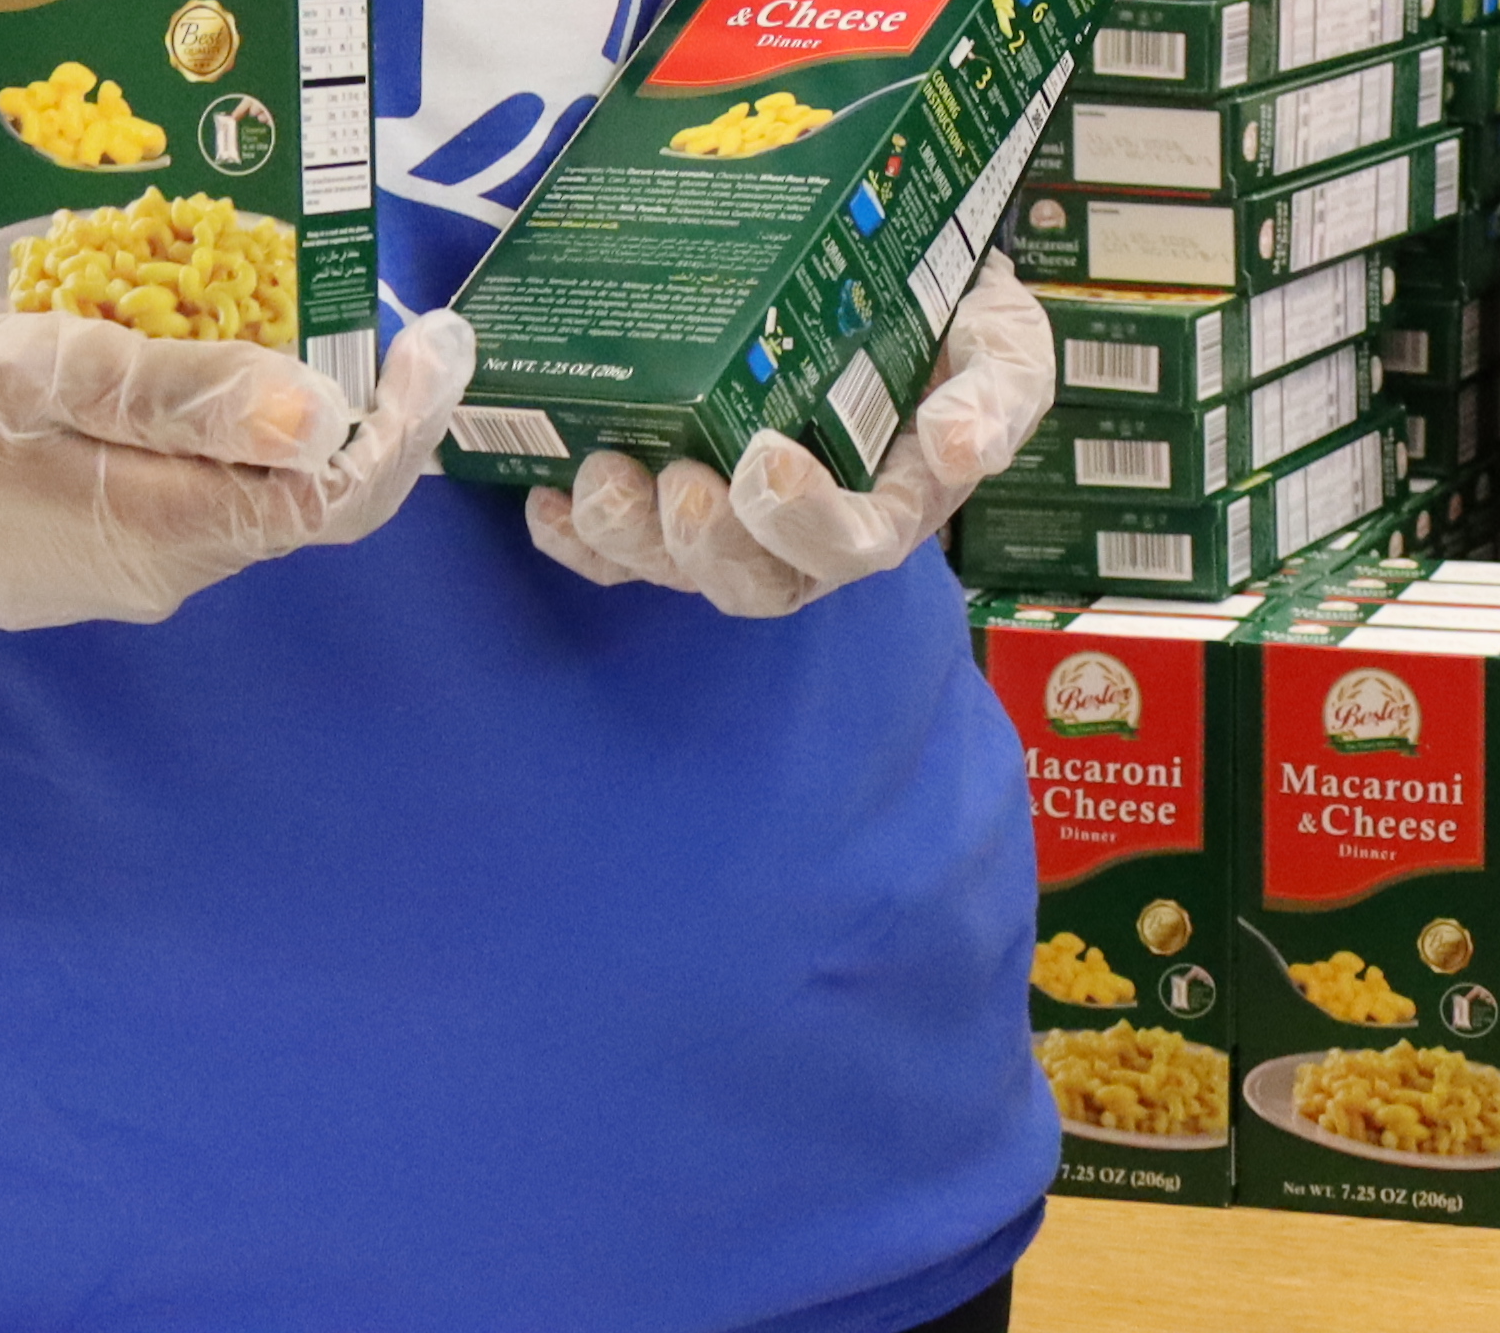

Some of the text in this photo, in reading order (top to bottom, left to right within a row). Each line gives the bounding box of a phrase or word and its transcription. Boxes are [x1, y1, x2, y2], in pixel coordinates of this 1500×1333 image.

[1032, 2, 1049, 24] 6
[180, 21, 224, 47] Best
[756, 34, 822, 50] Dinner
[1008, 29, 1026, 55] 2
[975, 65, 992, 90] 3
[932, 69, 962, 120] COOKING
[922, 82, 966, 159] INSTRUCTIONS
[932, 164, 954, 203] WATER
[1013, 234, 1080, 255] Macaroni
[483, 357, 508, 372] Net
[539, 360, 567, 375] 7.25
[568, 361, 591, 376] OZ
[1280, 761, 1464, 806] Macaroni
[1059, 826, 1117, 843] Dinner
[1338, 842, 1398, 861] Dinner
[1060, 1163, 1181, 1192] 7.25 OZ (206g)
[1283, 1180, 1306, 1195] Net
[1341, 1183, 1376, 1202] 7.25
[1379, 1188, 1407, 1205] OZ
[1411, 1190, 1464, 1214] (206g)
